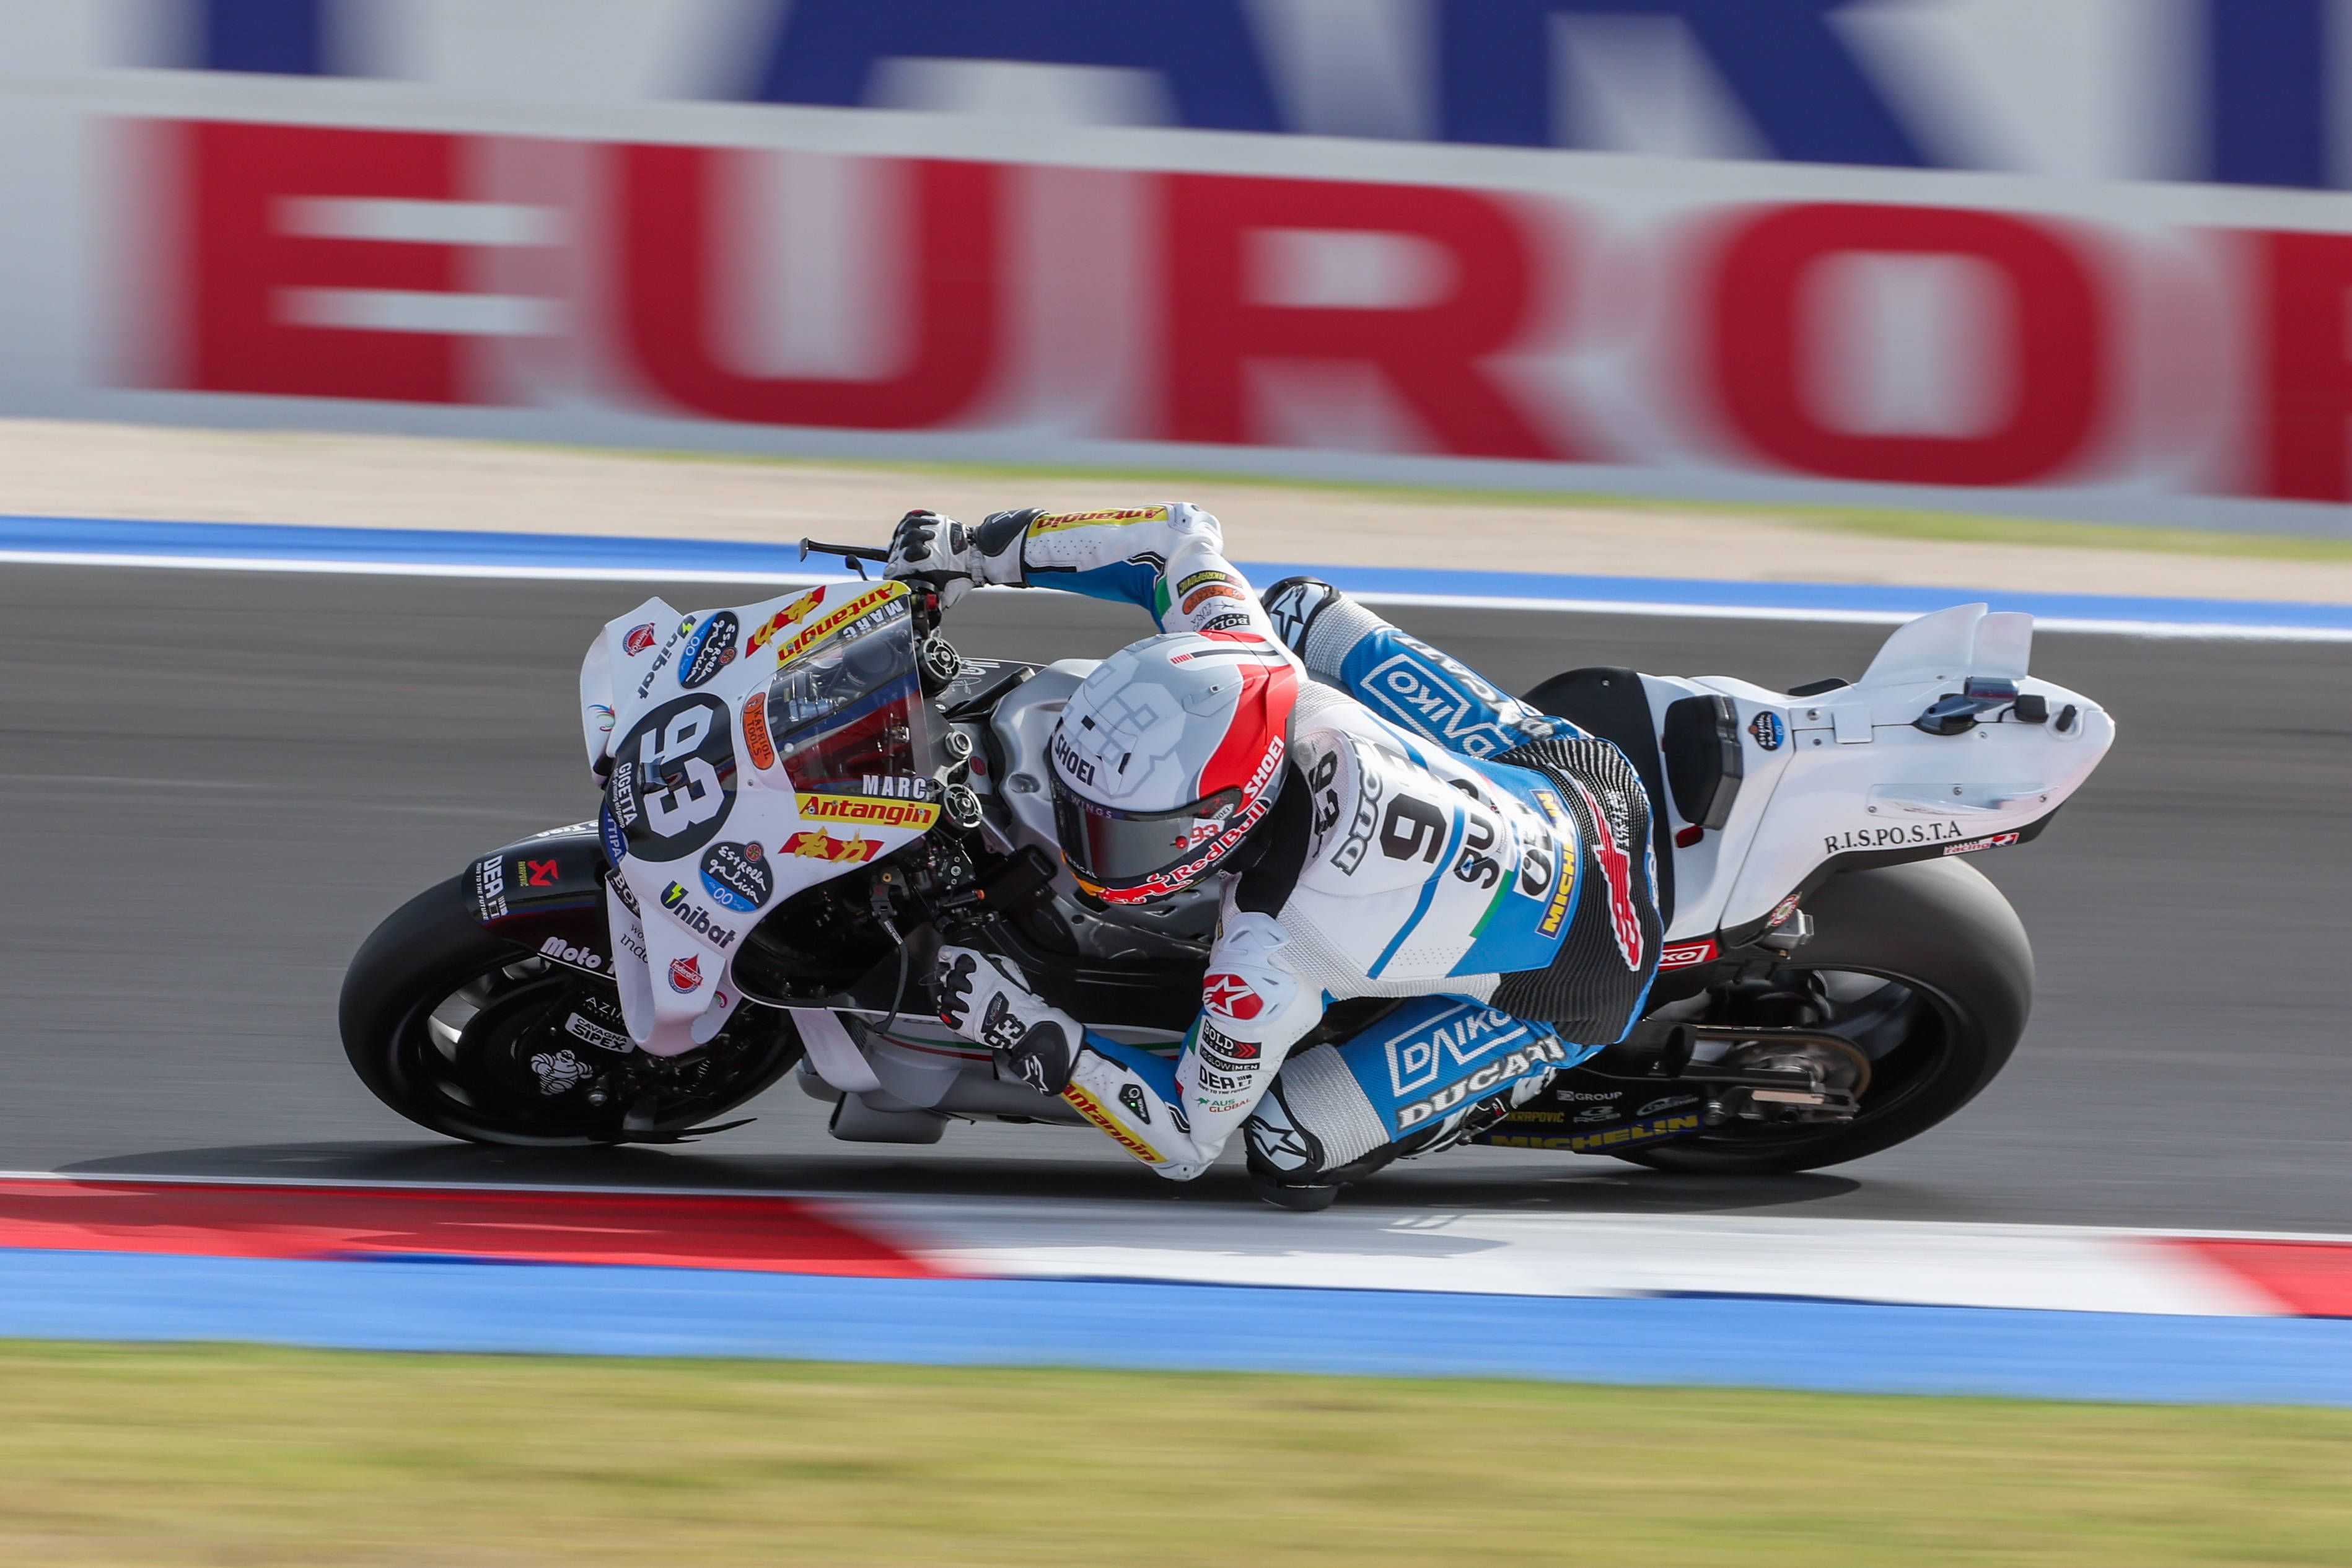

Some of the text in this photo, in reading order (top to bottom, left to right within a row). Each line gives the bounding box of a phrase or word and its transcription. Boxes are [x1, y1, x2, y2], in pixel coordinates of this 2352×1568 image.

[118, 114, 2352, 501] EURO
[1037, 509, 1166, 529] Antangin
[778, 583, 893, 661] Antangin
[842, 599, 905, 642] MARC
[637, 615, 697, 699] Unibat
[745, 721, 763, 757] TOOLS
[753, 709, 770, 761] KAPRIOL
[640, 704, 725, 839] 93
[1055, 734, 1095, 787] SHOEI
[1243, 735, 1285, 800] SHOEI
[618, 761, 638, 826] GIGETTA
[861, 774, 927, 800] MARC
[800, 796, 932, 826] Antangin
[1170, 841, 1224, 882] Red
[1220, 800, 1269, 849] Bull
[1189, 821, 1221, 844] 93
[483, 854, 506, 899] DEA
[478, 895, 489, 921] FUTURE
[660, 880, 737, 949] Unibat
[540, 936, 603, 969] Moto
[571, 1025, 626, 1051] SIPEX
[577, 1017, 627, 1043] CAVAGNA
[1203, 1021, 1234, 1049] BOLD
[1200, 1064, 1233, 1090] DEA
[1398, 1036, 1566, 1130] DUCATI
[1209, 1098, 1252, 1113] GLOBAL
[1211, 1098, 1235, 1106] AUS
[1574, 1091, 1623, 1102] GROUP
[1491, 1115, 1699, 1150] MICHELIN
